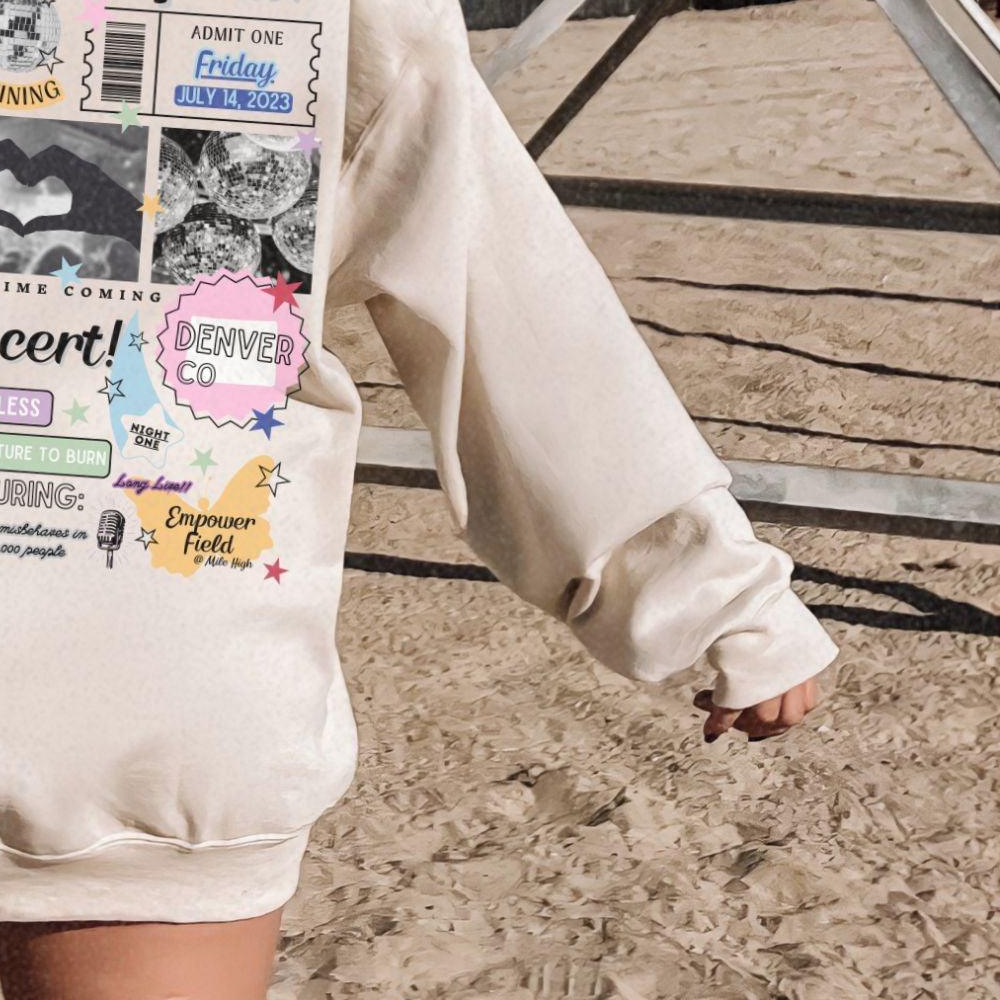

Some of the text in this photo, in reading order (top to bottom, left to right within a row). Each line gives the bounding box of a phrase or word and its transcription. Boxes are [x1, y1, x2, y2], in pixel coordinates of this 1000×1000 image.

[191, 25, 284, 45] ADMIT ONE
[177, 86, 290, 110] JULY 14, 2023
[64, 286, 162, 303] COMING
[174, 320, 294, 366] DENVER
[177, 360, 217, 387] CO
[130, 422, 170, 442] NIGHT
[134, 435, 160, 450] ONE
[39, 448, 61, 463] TO
[66, 450, 107, 466] BURN
[113, 472, 149, 495] Long
[165, 505, 256, 535] Empower
[0, 523, 70, 538] misbehaves
[72, 529, 87, 540] in
[19, 544, 66, 560] people
[183, 531, 234, 555] Field
[204, 555, 228, 567] Mile
[231, 557, 253, 571] High
